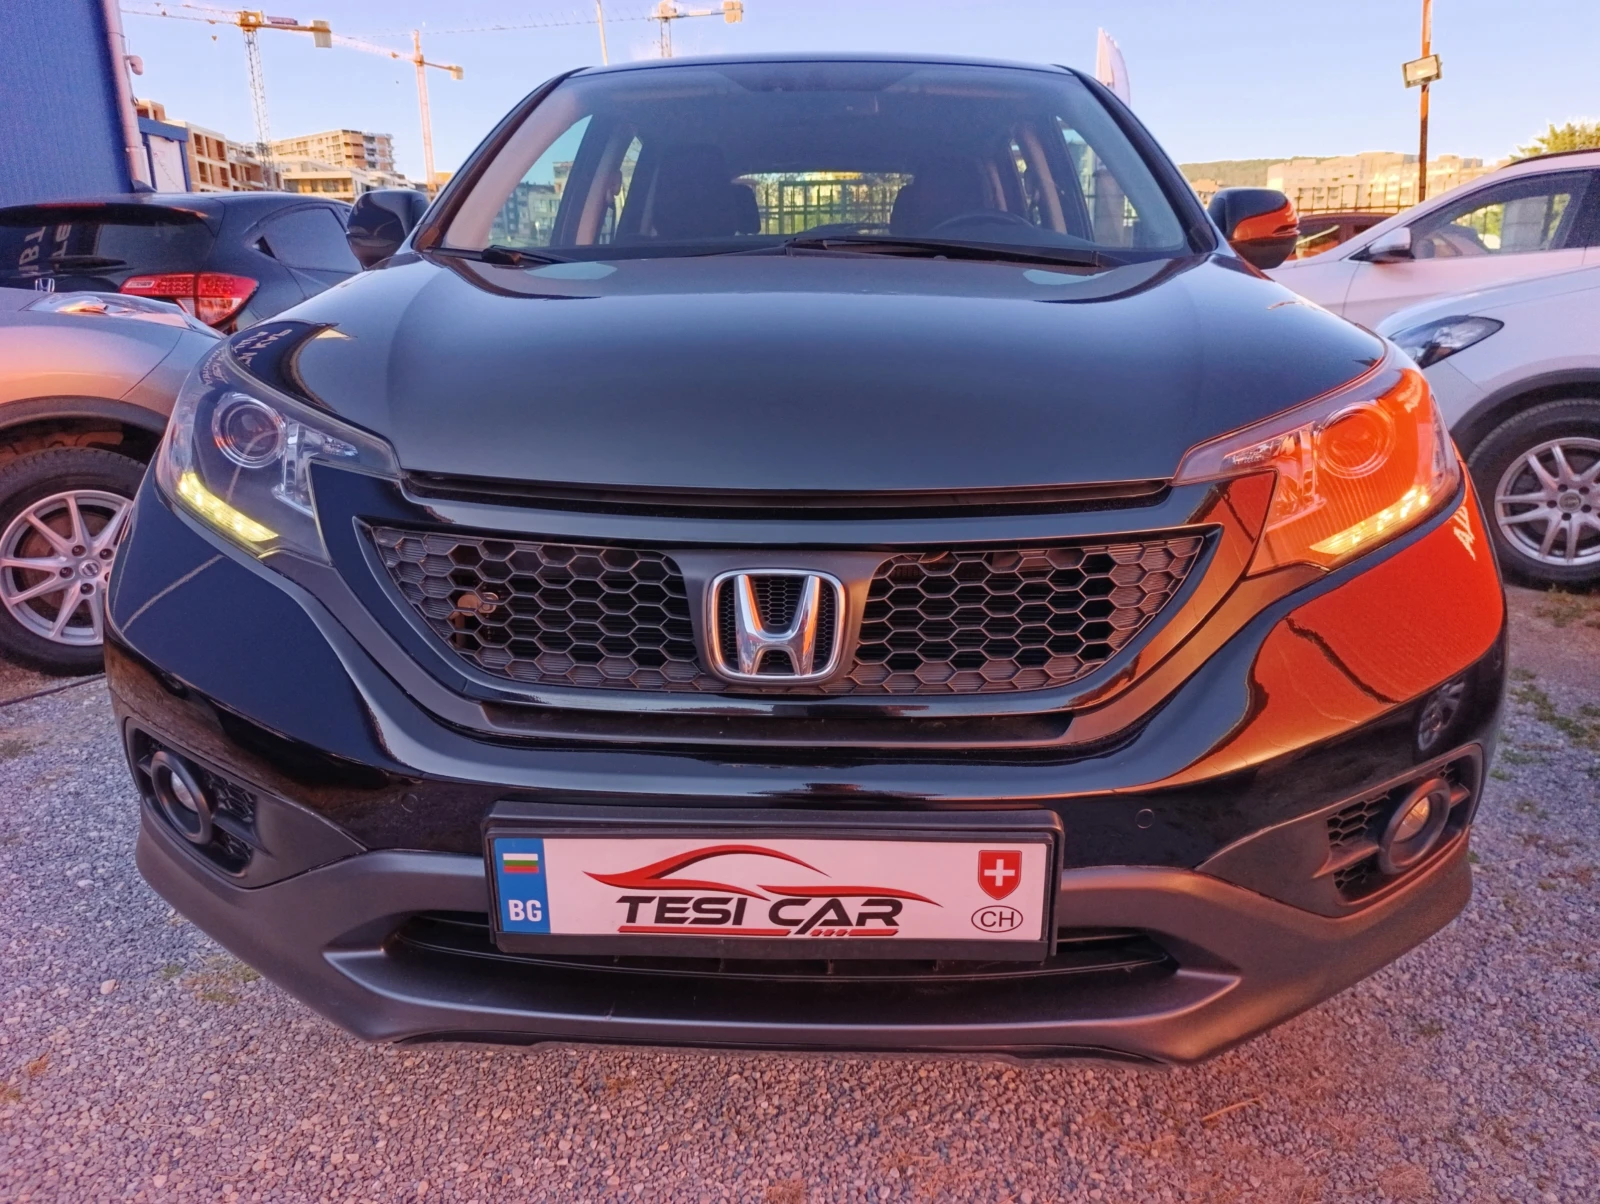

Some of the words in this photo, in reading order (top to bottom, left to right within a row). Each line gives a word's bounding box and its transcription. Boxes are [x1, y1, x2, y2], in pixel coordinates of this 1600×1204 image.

[508, 899, 542, 922] BG
[616, 895, 748, 925] TESI
[768, 898, 904, 935] CAR
[980, 911, 1015, 928] CH
